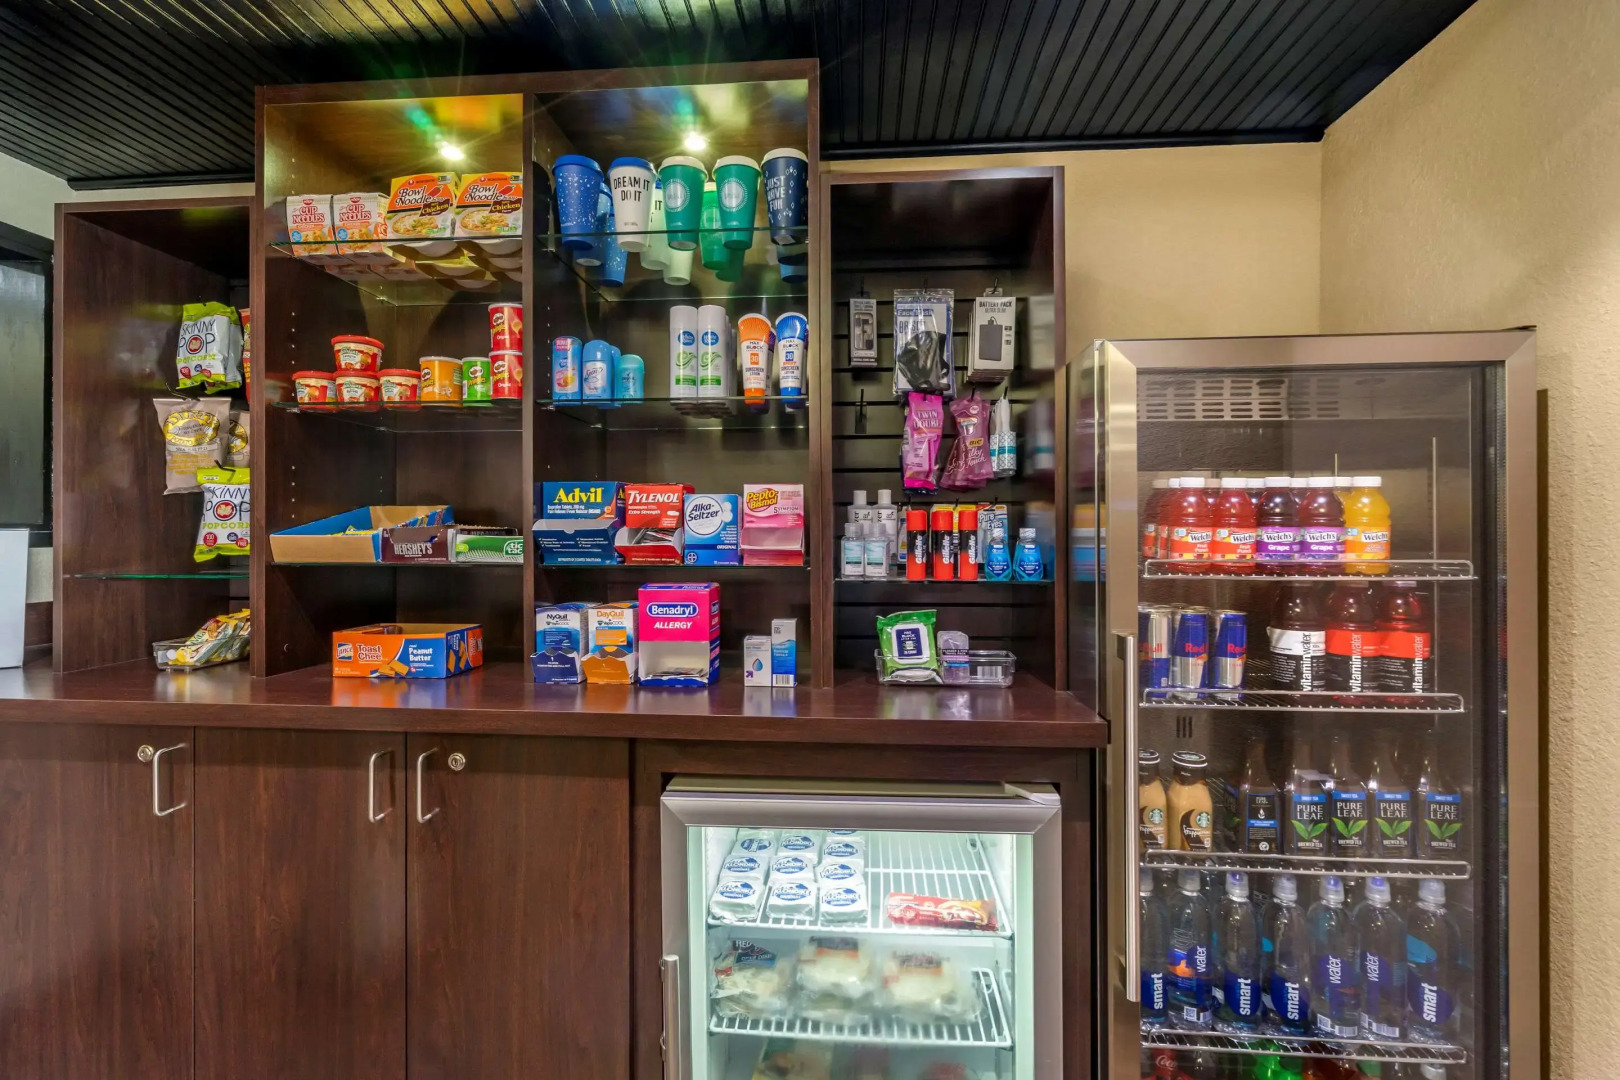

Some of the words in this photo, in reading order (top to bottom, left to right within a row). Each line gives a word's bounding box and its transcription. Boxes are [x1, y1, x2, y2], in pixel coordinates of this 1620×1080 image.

[614, 176, 640, 189] DREAM
[643, 179, 650, 191] IT
[766, 176, 786, 188] JUST
[398, 186, 426, 198] Bowl
[469, 184, 498, 194] Bowl
[767, 187, 786, 200] HAVE
[394, 195, 432, 207] Noodle
[464, 192, 502, 202] Noodle
[620, 190, 632, 202] DO
[634, 190, 642, 202] IT
[299, 206, 318, 216] CUP
[346, 204, 365, 214] CUP
[422, 203, 448, 215] Chicken
[492, 203, 520, 212] Chicken
[769, 200, 784, 211] FUN
[292, 213, 326, 224] NOODLES
[339, 211, 372, 222] NOODLES
[181, 319, 216, 338] SKINNY
[178, 332, 216, 358] POP
[554, 487, 603, 504] Advil
[628, 490, 680, 504] TYLENOL
[746, 488, 779, 501] Pepto-
[690, 502, 715, 513] Alka-
[750, 498, 778, 510] Bismol
[774, 506, 778, 514] 5
[688, 510, 720, 522] Seltzer
[980, 514, 994, 522] Pure
[987, 520, 1002, 530] Eyes
[1266, 532, 1292, 541] Welch's
[1308, 532, 1336, 541] Welch's
[394, 542, 432, 555] HERSHEY'S
[942, 534, 950, 564] Gillette
[968, 534, 976, 564] Gillette
[596, 610, 624, 618] DayQuil
[652, 604, 694, 616] Benadryl
[356, 643, 382, 653] Toast
[1184, 642, 1206, 653] Red
[1227, 642, 1246, 653] Red
[358, 652, 382, 660] Chee
[410, 654, 432, 662] Butter
[1301, 632, 1312, 692] vitaminwater
[1350, 633, 1362, 692] vitaminwater
[1296, 804, 1324, 812] PURE
[1336, 802, 1362, 810] PURE
[1380, 802, 1407, 810] PURE
[1430, 804, 1457, 812] PURE
[1196, 946, 1206, 973] water
[1329, 954, 1341, 984] water
[1366, 952, 1379, 982] water
[1151, 972, 1163, 1010] smart
[1238, 978, 1252, 1016] smart
[1284, 982, 1299, 1020] smart
[1420, 982, 1438, 1023] smart
